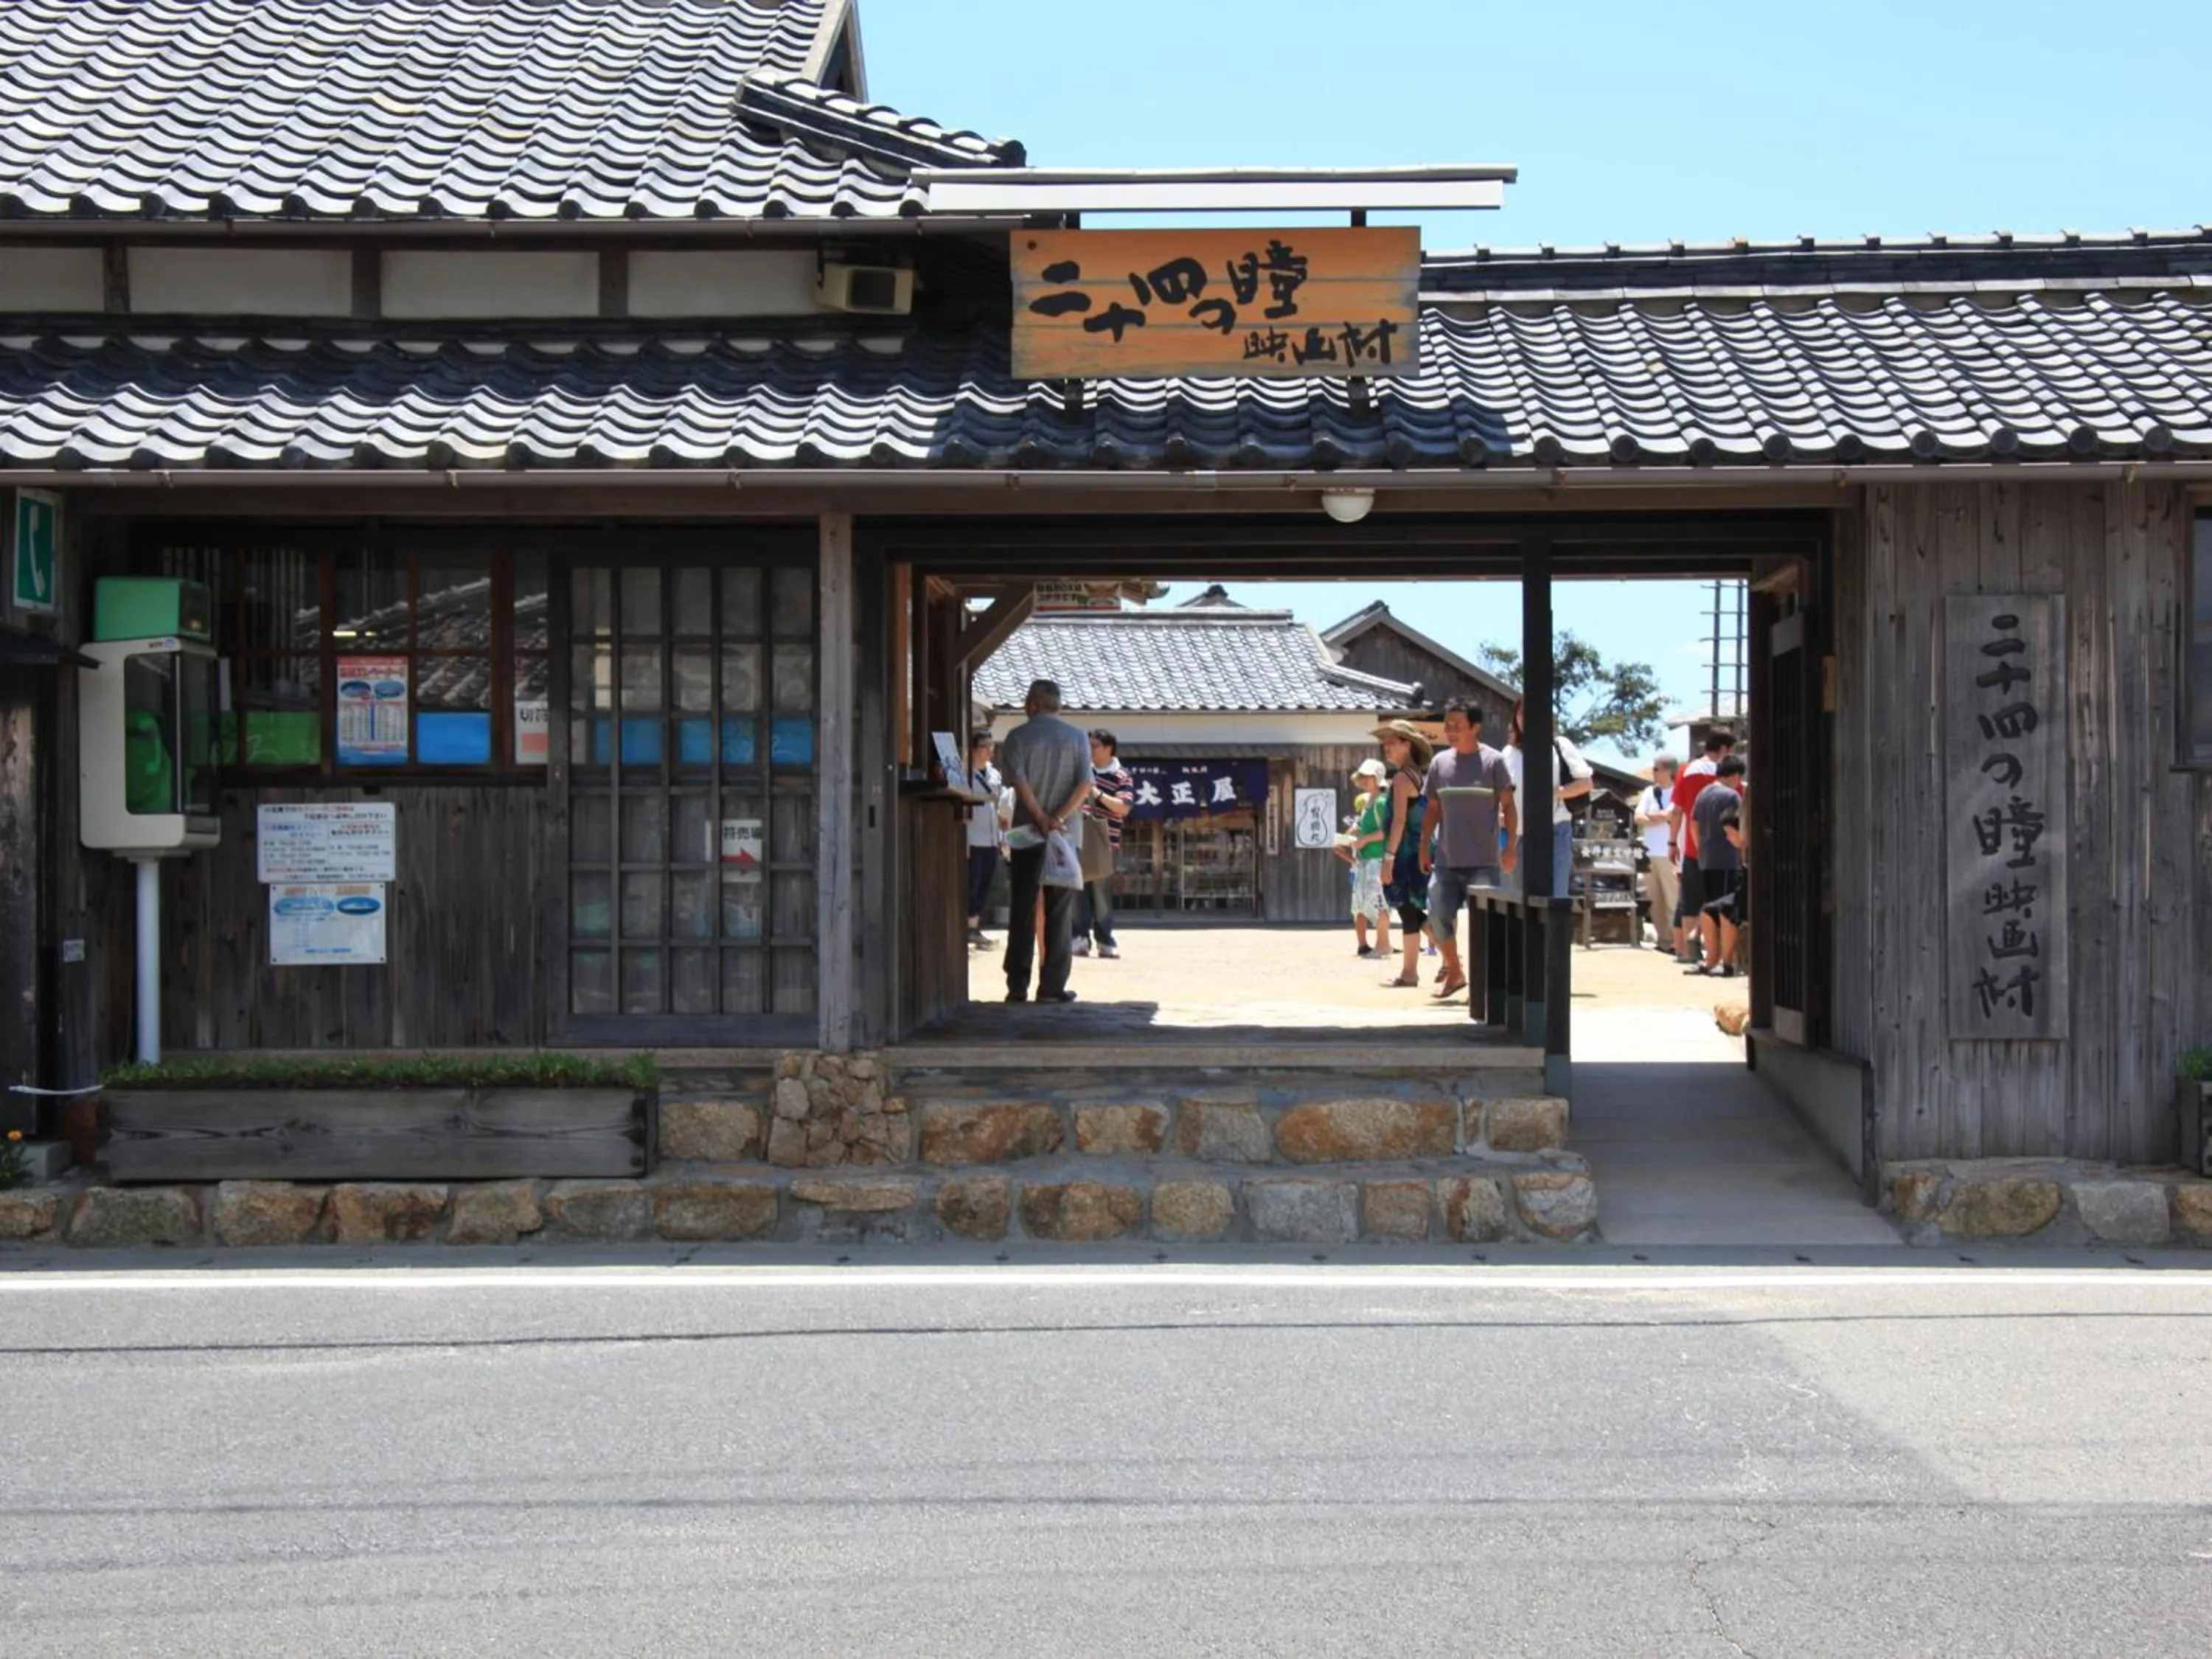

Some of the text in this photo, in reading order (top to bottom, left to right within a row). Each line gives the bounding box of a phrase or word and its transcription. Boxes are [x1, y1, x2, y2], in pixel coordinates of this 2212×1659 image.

[1029, 240, 1308, 343] 二十四の瞳
[1243, 319, 1398, 368] 映画村
[1134, 776, 1237, 806] 大正屋
